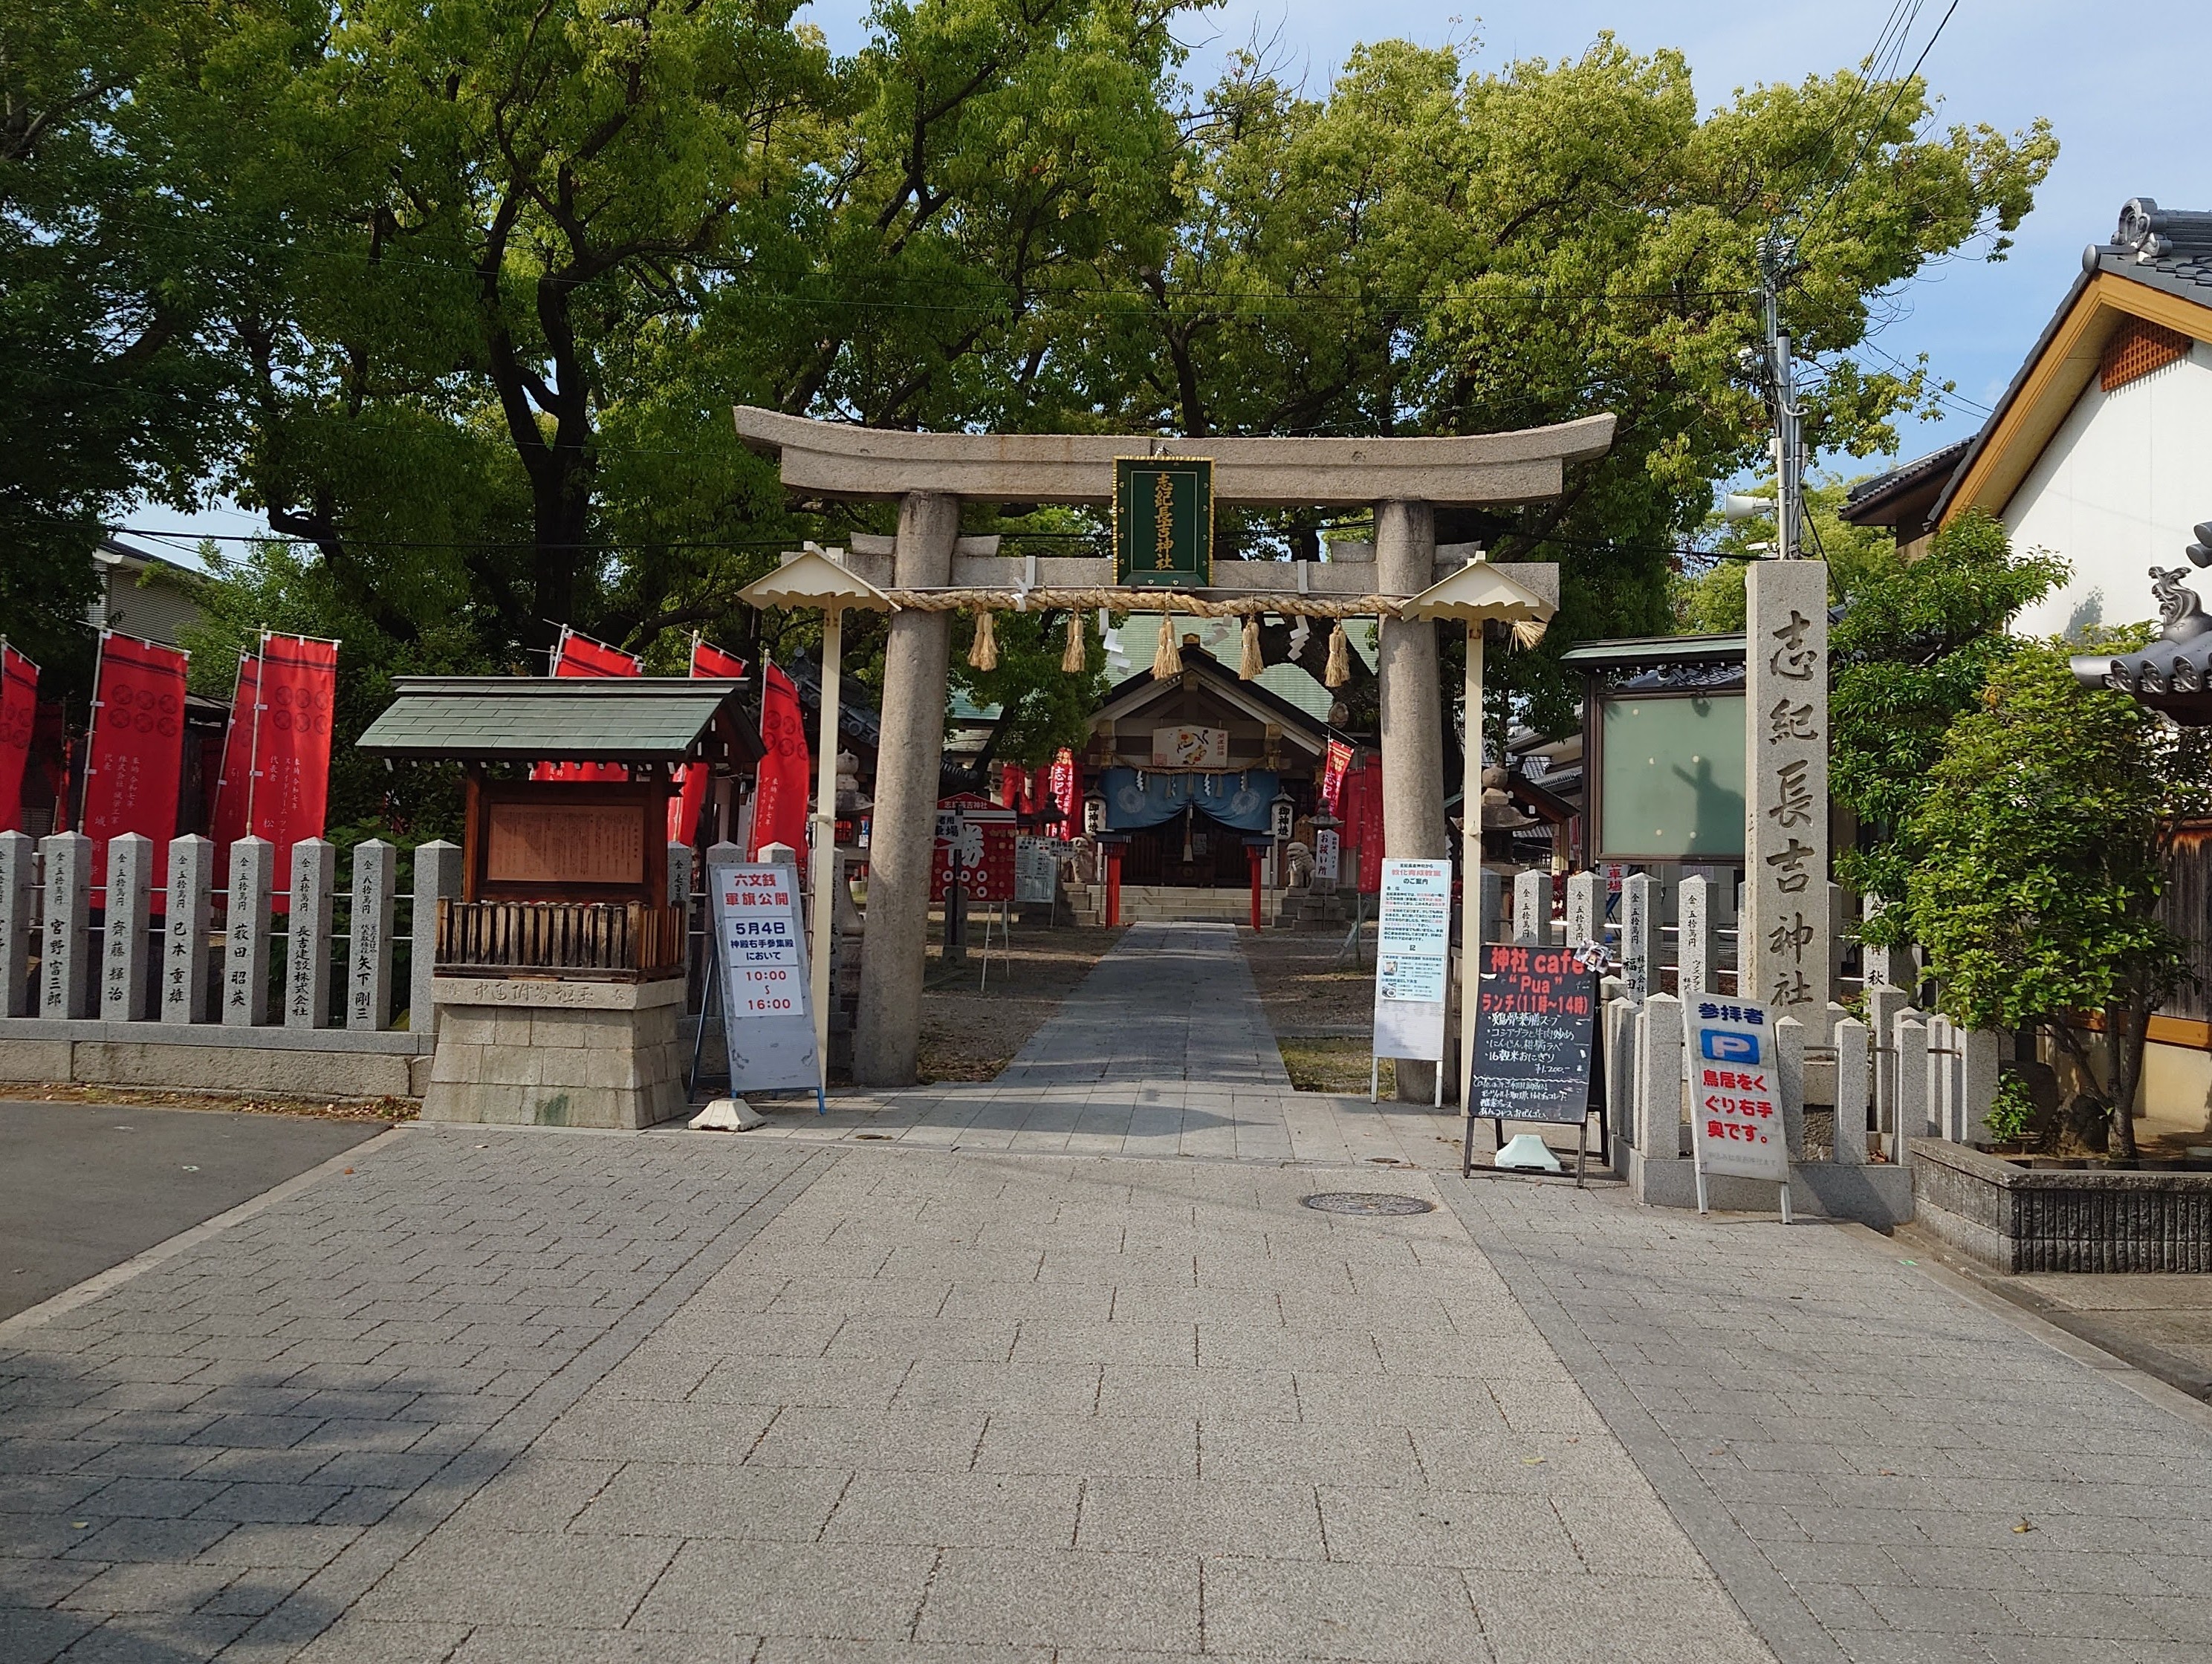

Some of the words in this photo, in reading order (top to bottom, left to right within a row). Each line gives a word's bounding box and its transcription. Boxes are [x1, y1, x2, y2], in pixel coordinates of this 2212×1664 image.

[1154, 472, 1174, 570] 志紀長吉神社
[1765, 609, 1818, 1007] 志紀長吉神社
[734, 873, 776, 887] 六文銭
[725, 892, 788, 906] 軍旗公開
[736, 922, 785, 935] 5月4日
[746, 952, 781, 961] において
[1491, 946, 1529, 973] 神社
[746, 971, 786, 981] 10:00
[748, 999, 791, 1010] 16:00
[1699, 1002, 1764, 1025] 参拝者
[1711, 1036, 1751, 1058] P
[1703, 1069, 1768, 1092] 鳥居をく
[1705, 1095, 1773, 1118] ぐり右手
[1707, 1119, 1768, 1144] 奥です。
